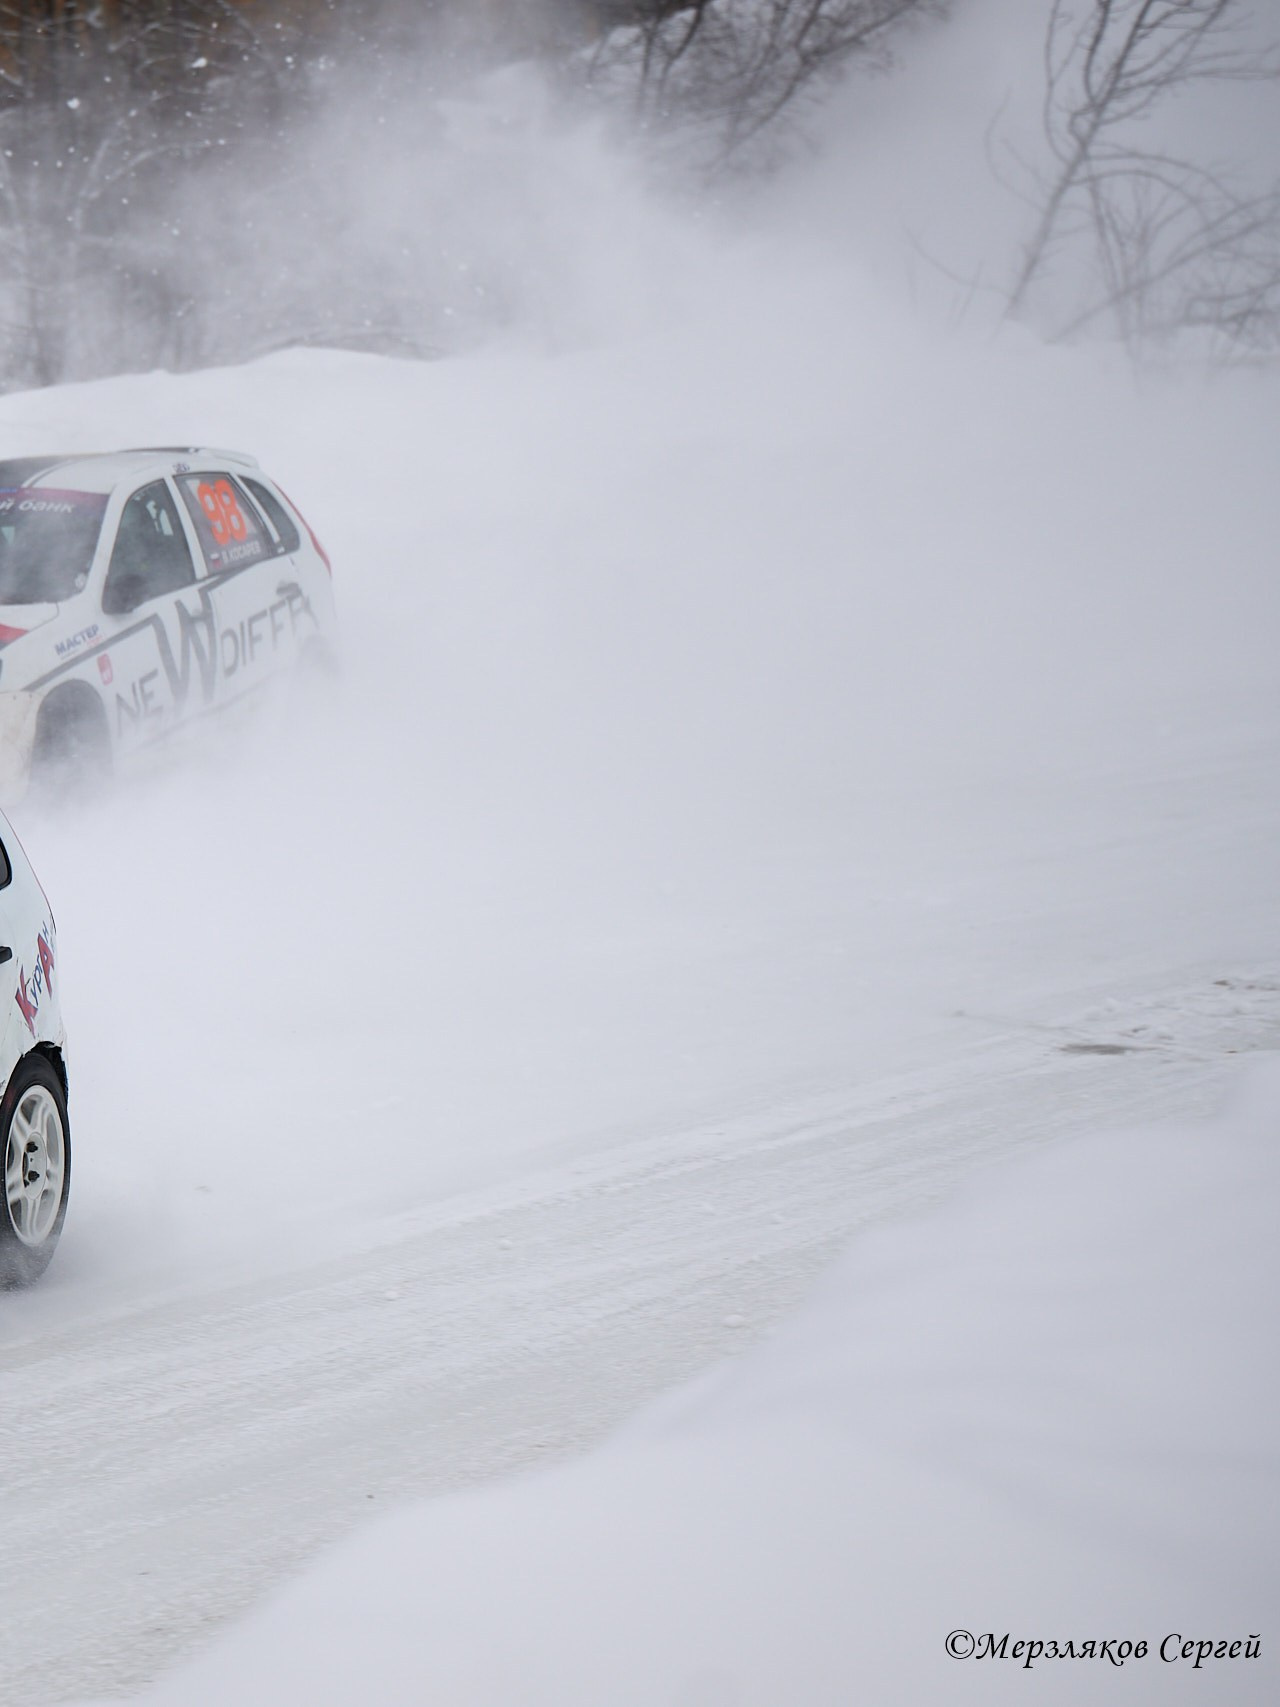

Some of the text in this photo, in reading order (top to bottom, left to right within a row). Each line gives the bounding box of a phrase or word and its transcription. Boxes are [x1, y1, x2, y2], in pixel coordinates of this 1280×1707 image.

[19, 499, 76, 513] банк
[197, 479, 247, 545] 98
[54, 623, 99, 656] МАСТЕР
